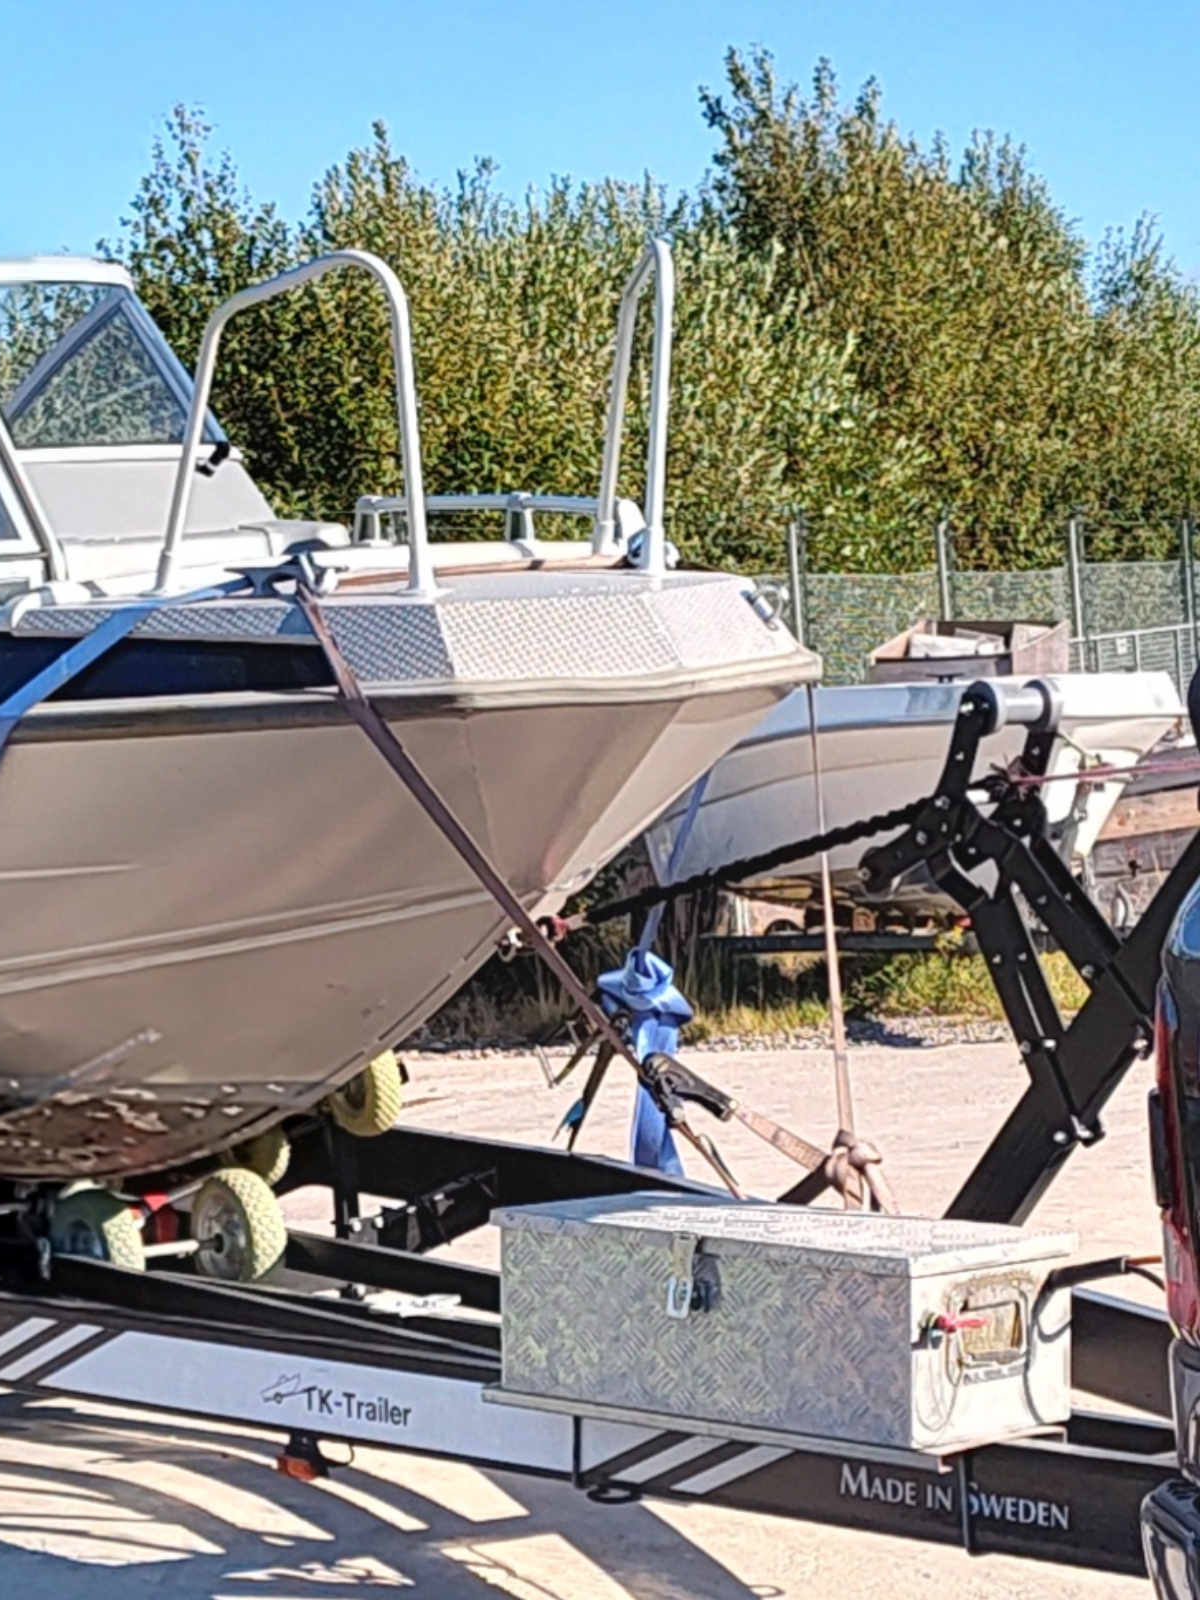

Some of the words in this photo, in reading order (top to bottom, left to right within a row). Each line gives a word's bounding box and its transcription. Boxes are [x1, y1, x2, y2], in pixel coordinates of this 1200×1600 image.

[303, 1385, 412, 1427] TK-Trailer
[839, 1462, 917, 1506] MADE
[926, 1484, 952, 1512] IN
